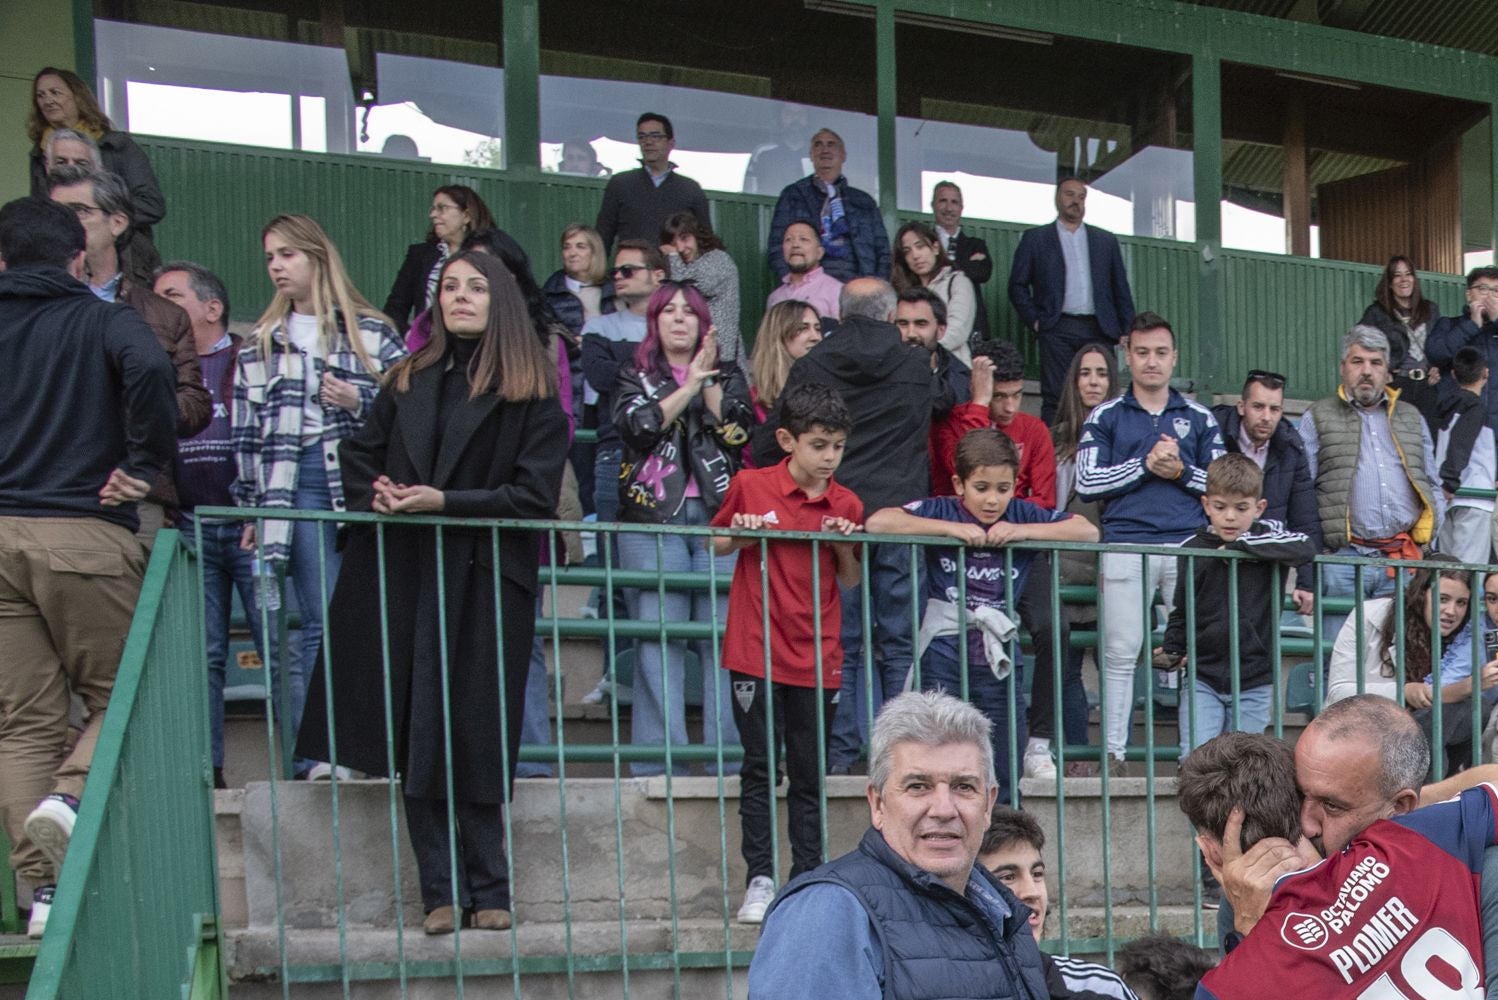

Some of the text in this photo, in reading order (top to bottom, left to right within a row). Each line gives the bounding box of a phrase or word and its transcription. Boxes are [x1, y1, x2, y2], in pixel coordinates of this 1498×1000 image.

[1320, 855, 1377, 922] OCTAVIANO
[1328, 862, 1391, 936] PALOMO
[1328, 896, 1420, 985] PLOMER
